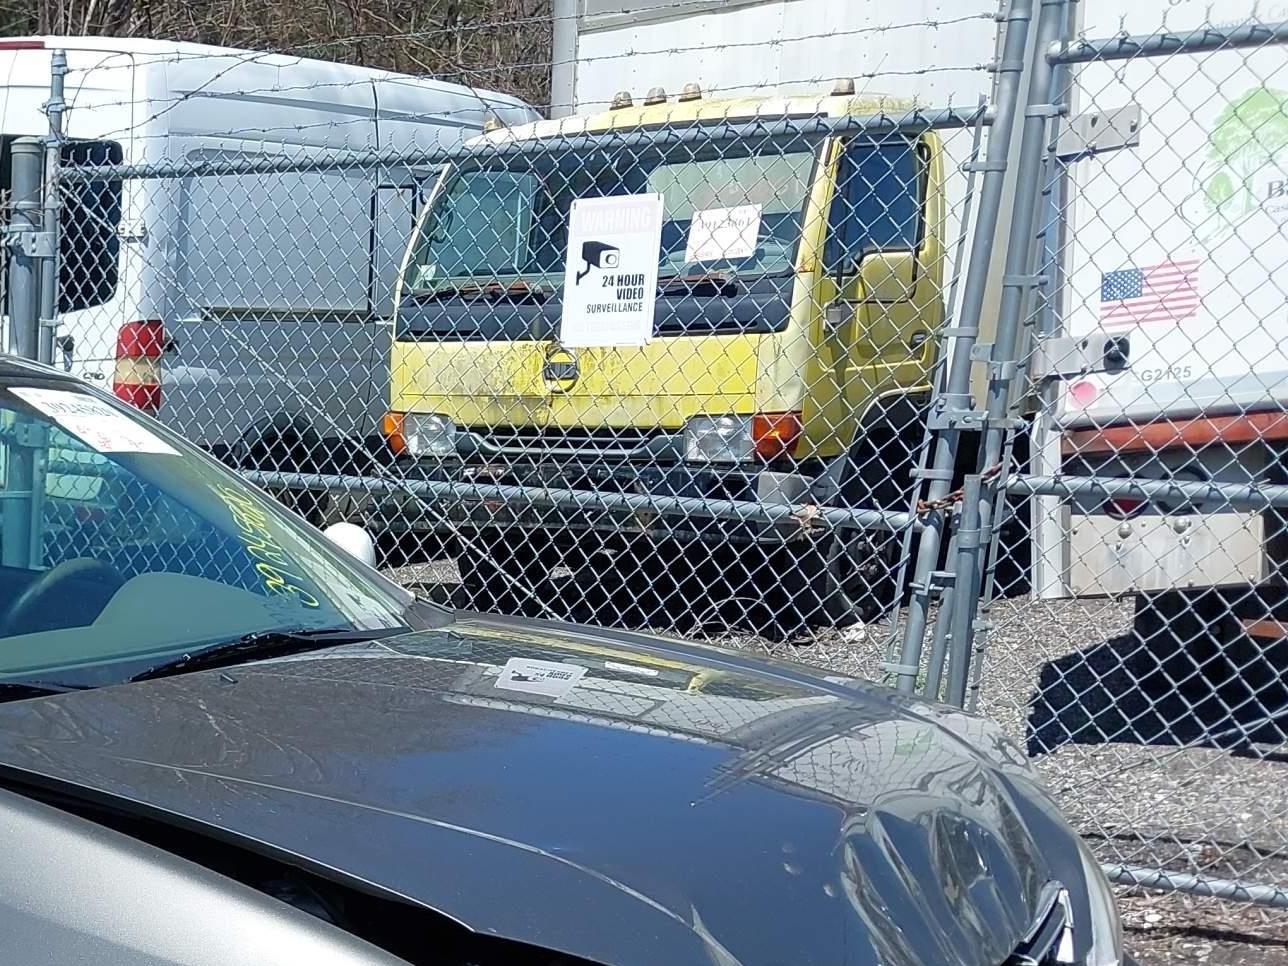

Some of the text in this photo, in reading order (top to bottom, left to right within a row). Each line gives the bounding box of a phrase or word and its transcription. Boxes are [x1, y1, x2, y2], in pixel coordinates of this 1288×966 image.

[1267, 178, 1288, 199] B
[583, 207, 650, 233] WARNING
[602, 274, 645, 288] 24 HOUR
[616, 287, 644, 300] VIDEO
[586, 302, 644, 314] SURVEILLANCE
[1141, 366, 1192, 382] G2125
